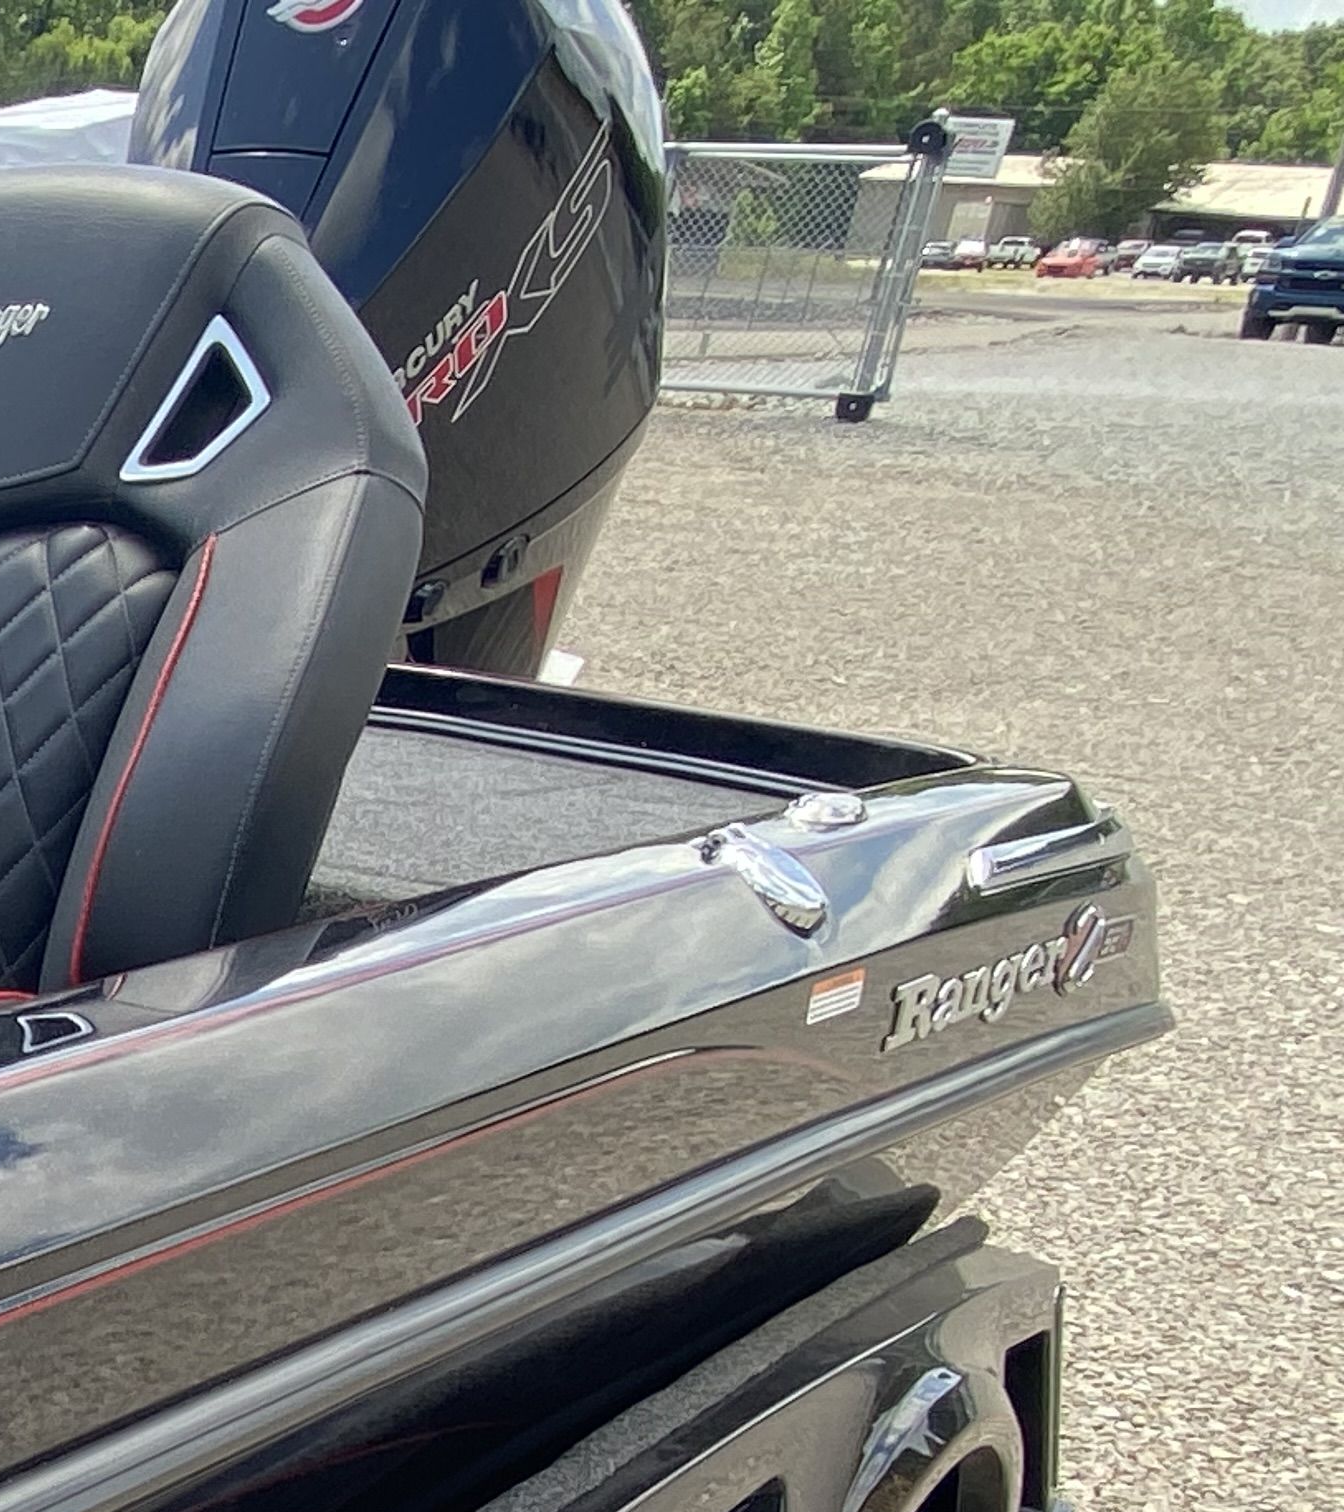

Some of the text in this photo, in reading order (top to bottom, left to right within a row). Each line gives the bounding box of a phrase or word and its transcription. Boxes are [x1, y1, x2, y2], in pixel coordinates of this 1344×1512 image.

[406, 117, 612, 426] RO XS
[884, 936, 1068, 1052] Ranger
